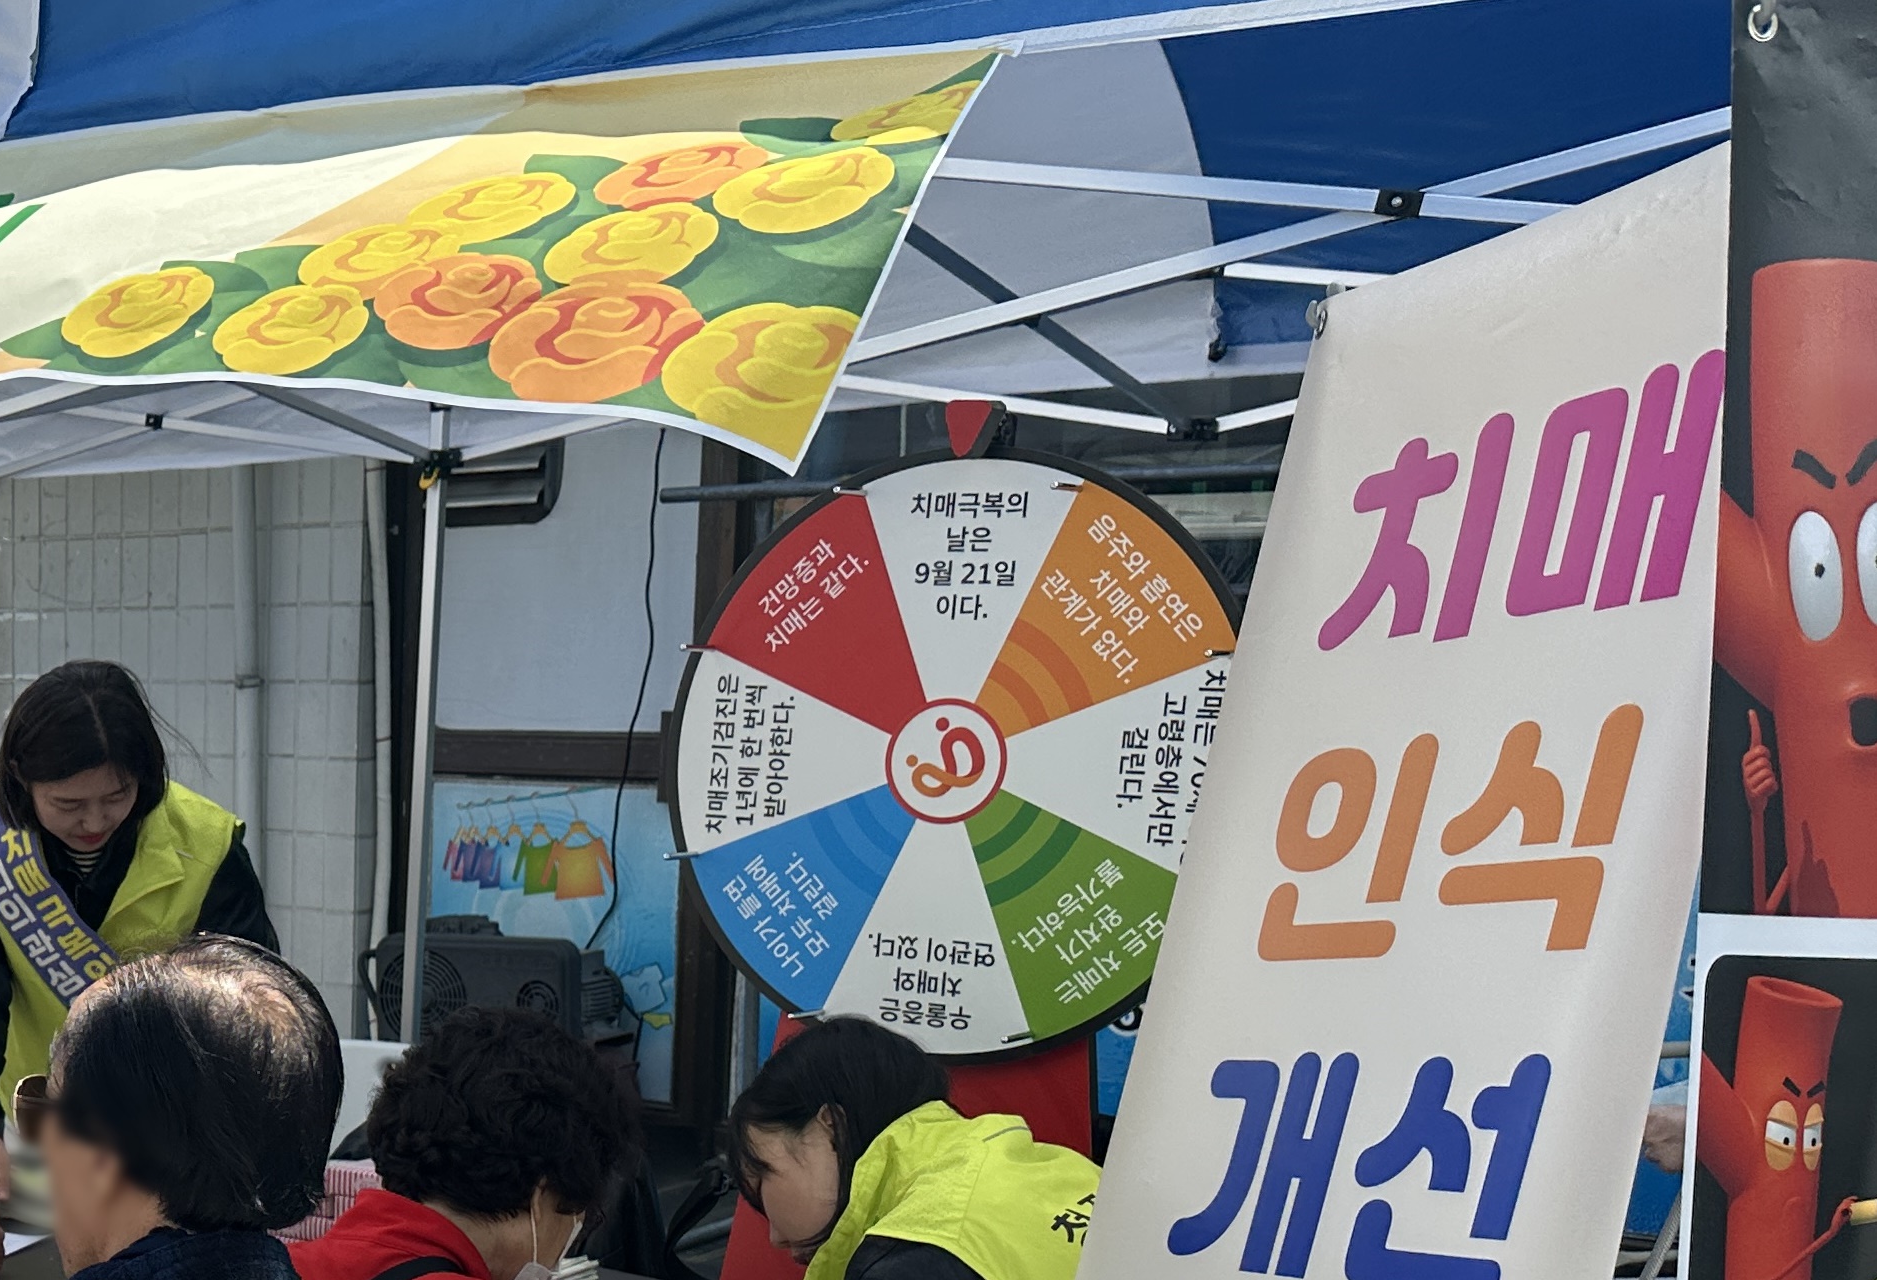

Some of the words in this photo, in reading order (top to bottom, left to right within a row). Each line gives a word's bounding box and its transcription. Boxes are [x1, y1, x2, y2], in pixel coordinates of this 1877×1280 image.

[910, 491, 1030, 519] 치매극복의
[1316, 348, 1727, 653] 치매
[946, 526, 992, 552] 날은
[758, 539, 835, 618] 건망증과
[765, 595, 824, 652] 치매는
[819, 553, 870, 600] 같다.
[914, 560, 953, 586] 9월
[961, 560, 1017, 587] 21일
[1087, 513, 1151, 581] 음주와
[1140, 574, 1203, 642] 흡연은
[1089, 569, 1150, 636] 치매와
[936, 594, 989, 621] 이다.
[1040, 569, 1103, 636] 관계가
[1091, 629, 1139, 684] 없다.
[743, 684, 768, 730] 번씩
[1192, 669, 1227, 746] 치매는
[705, 673, 740, 834] 치매조기검진은
[739, 738, 762, 760] 한
[763, 696, 796, 819] 받아야한다.
[1116, 728, 1149, 809] 걸린다.
[1146, 692, 1187, 847] 고령층에서만
[736, 766, 760, 826] 1년에
[1, 828, 51, 897] 치매
[1257, 701, 1645, 963] 인식
[723, 874, 763, 920] 들면
[743, 854, 796, 918] 치매에
[785, 851, 839, 921] 걸린다.
[1011, 858, 1124, 953] 불가능하다.
[21, 928, 87, 998] 관심
[753, 915, 805, 978] 나이가
[790, 915, 830, 958] 모두
[868, 933, 919, 960] 있다.
[926, 937, 995, 967] 연관이
[1055, 904, 1123, 965] 완치가
[1118, 911, 1166, 957] 모든
[893, 967, 962, 998] 치매와
[1054, 950, 1122, 1004] 치매는
[879, 998, 972, 1031] 우울증은
